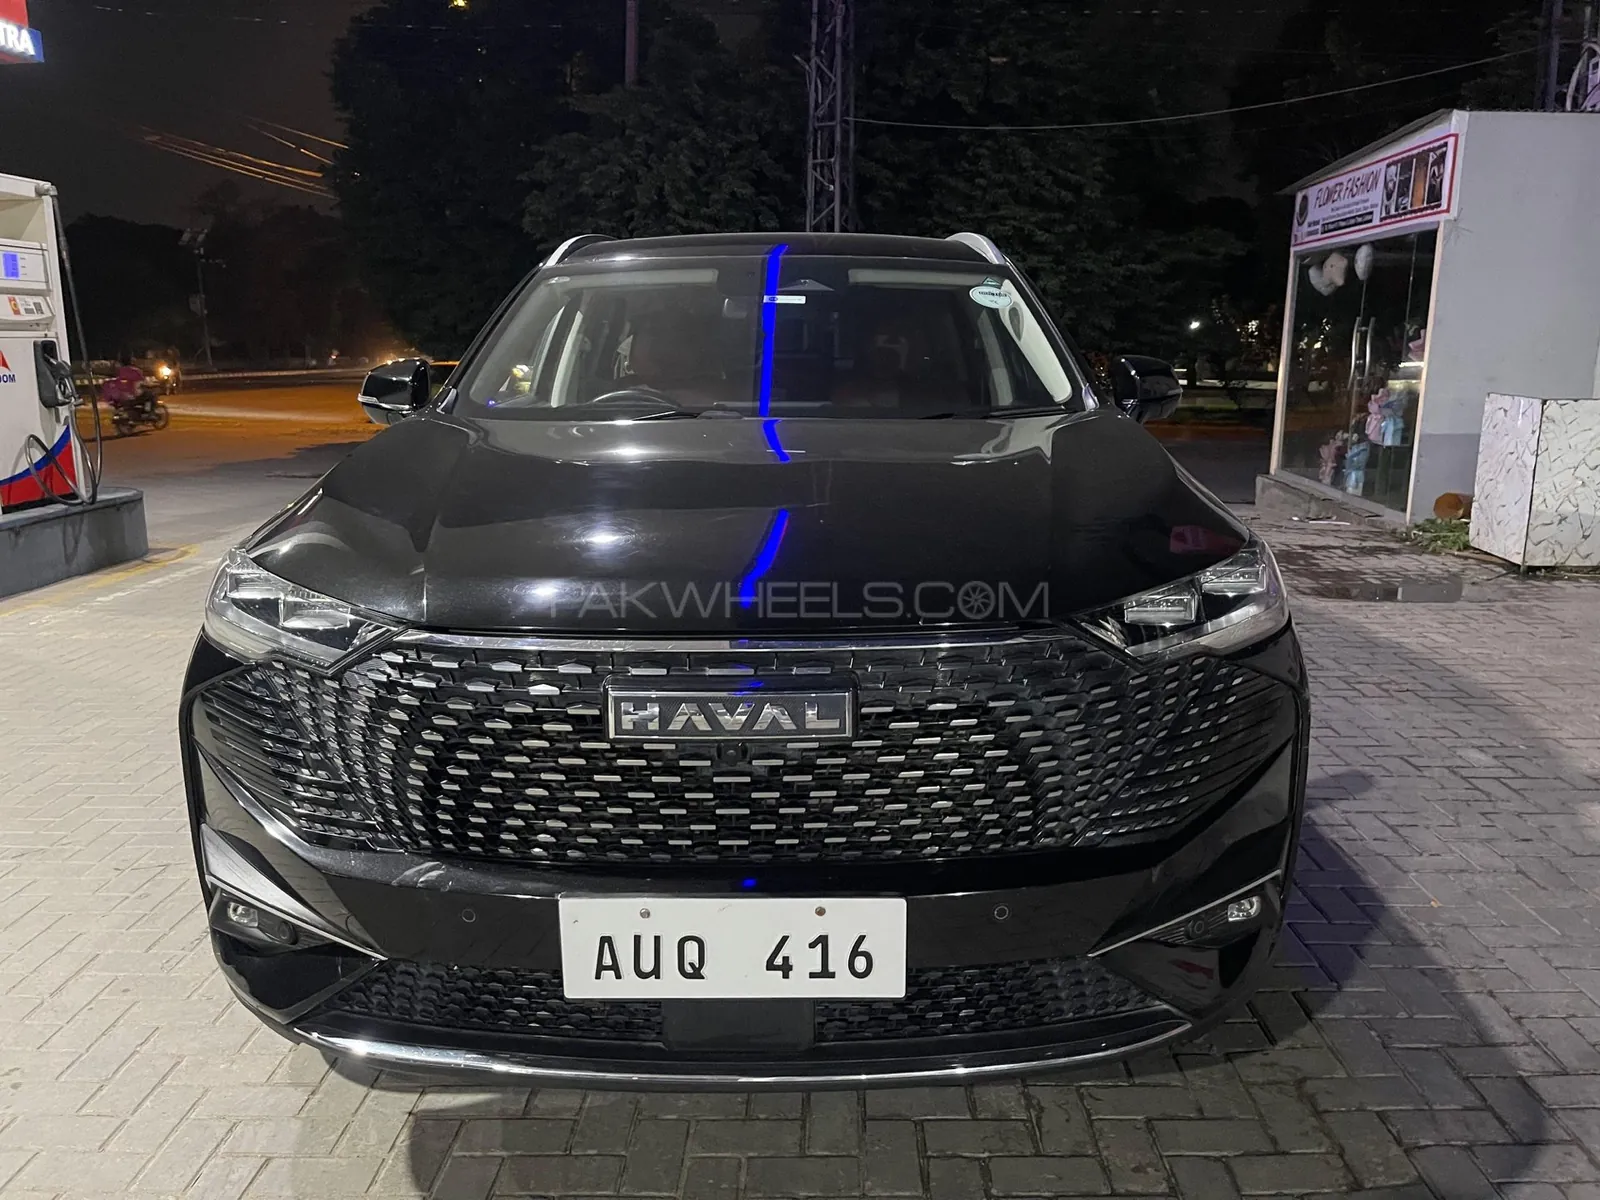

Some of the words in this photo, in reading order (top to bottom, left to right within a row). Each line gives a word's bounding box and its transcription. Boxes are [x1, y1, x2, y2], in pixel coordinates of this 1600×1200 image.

[1314, 181, 1344, 208] FLOWER
[1343, 168, 1382, 199] FASHION
[0, 373, 16, 384] OM
[620, 702, 840, 731] HAVAL
[594, 934, 706, 980] AUQ
[765, 934, 874, 980] 416
